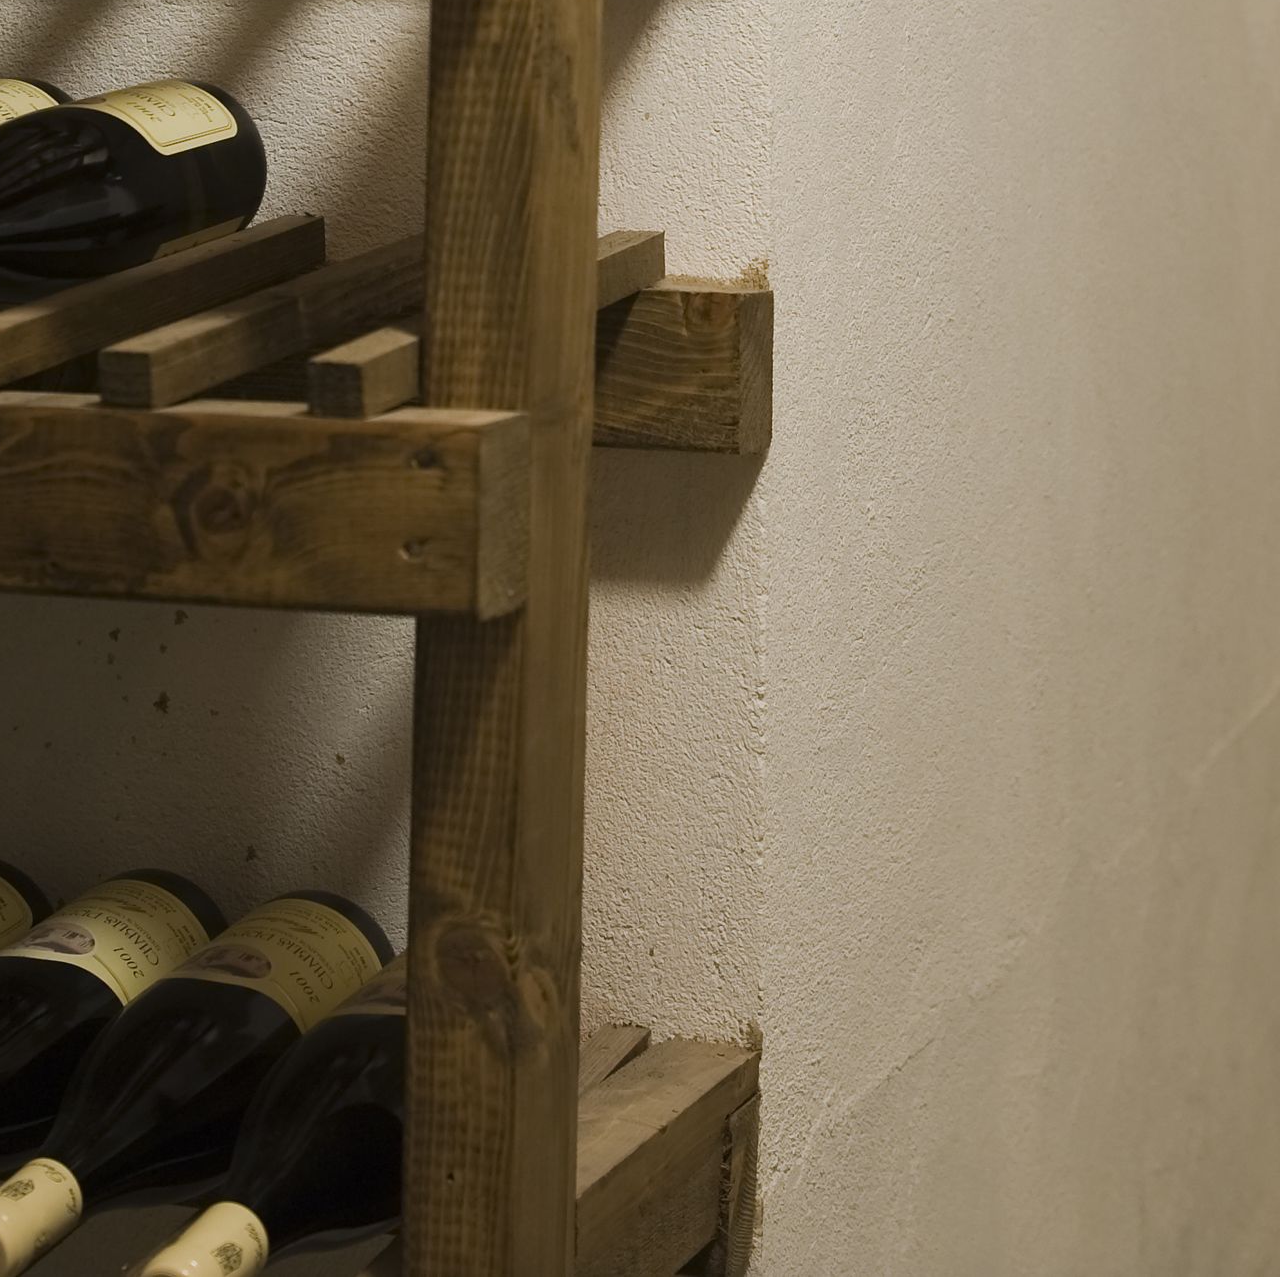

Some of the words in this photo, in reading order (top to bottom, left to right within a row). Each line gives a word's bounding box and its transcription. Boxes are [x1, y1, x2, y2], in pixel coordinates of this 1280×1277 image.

[104, 915, 159, 966] CHABLIS
[113, 947, 145, 979] 2001
[278, 936, 334, 990] CHABLIS
[289, 971, 320, 1003] 2001
